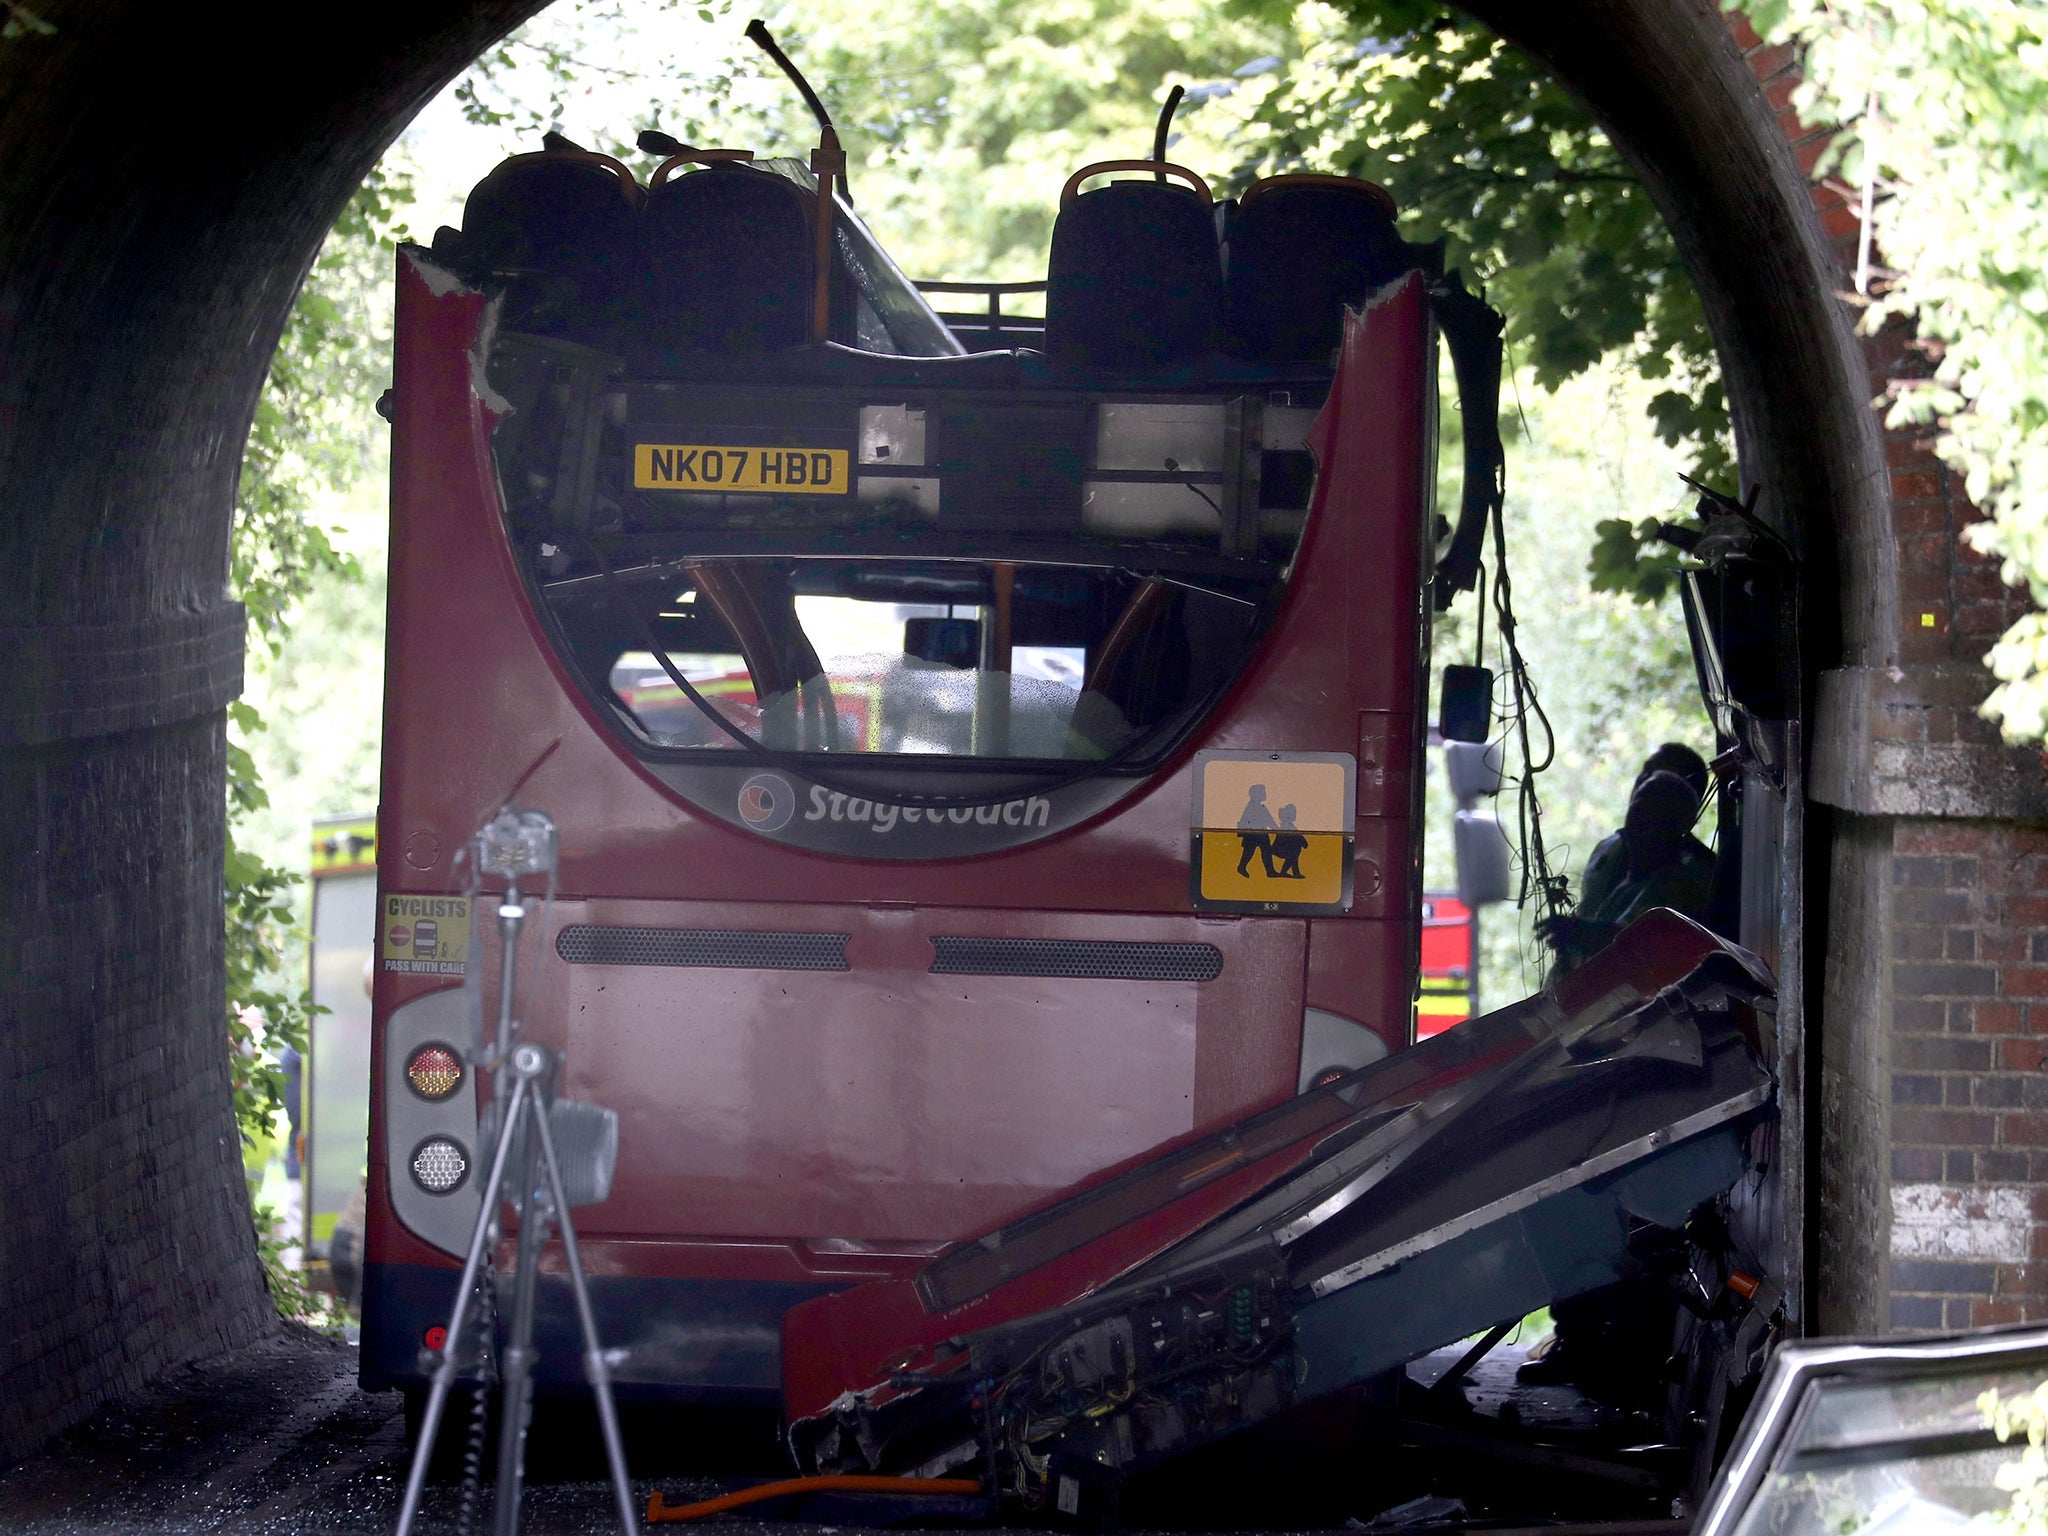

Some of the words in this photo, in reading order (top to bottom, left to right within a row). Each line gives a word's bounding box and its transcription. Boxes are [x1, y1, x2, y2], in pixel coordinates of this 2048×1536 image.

[651, 448, 748, 484] NK07
[760, 452, 833, 486] HBD
[804, 784, 1050, 833] Stagecoach
[388, 897, 467, 918] CYCLISTS
[385, 960, 409, 972] PASS
[411, 961, 438, 973] WITH
[440, 962, 465, 974] CARE
